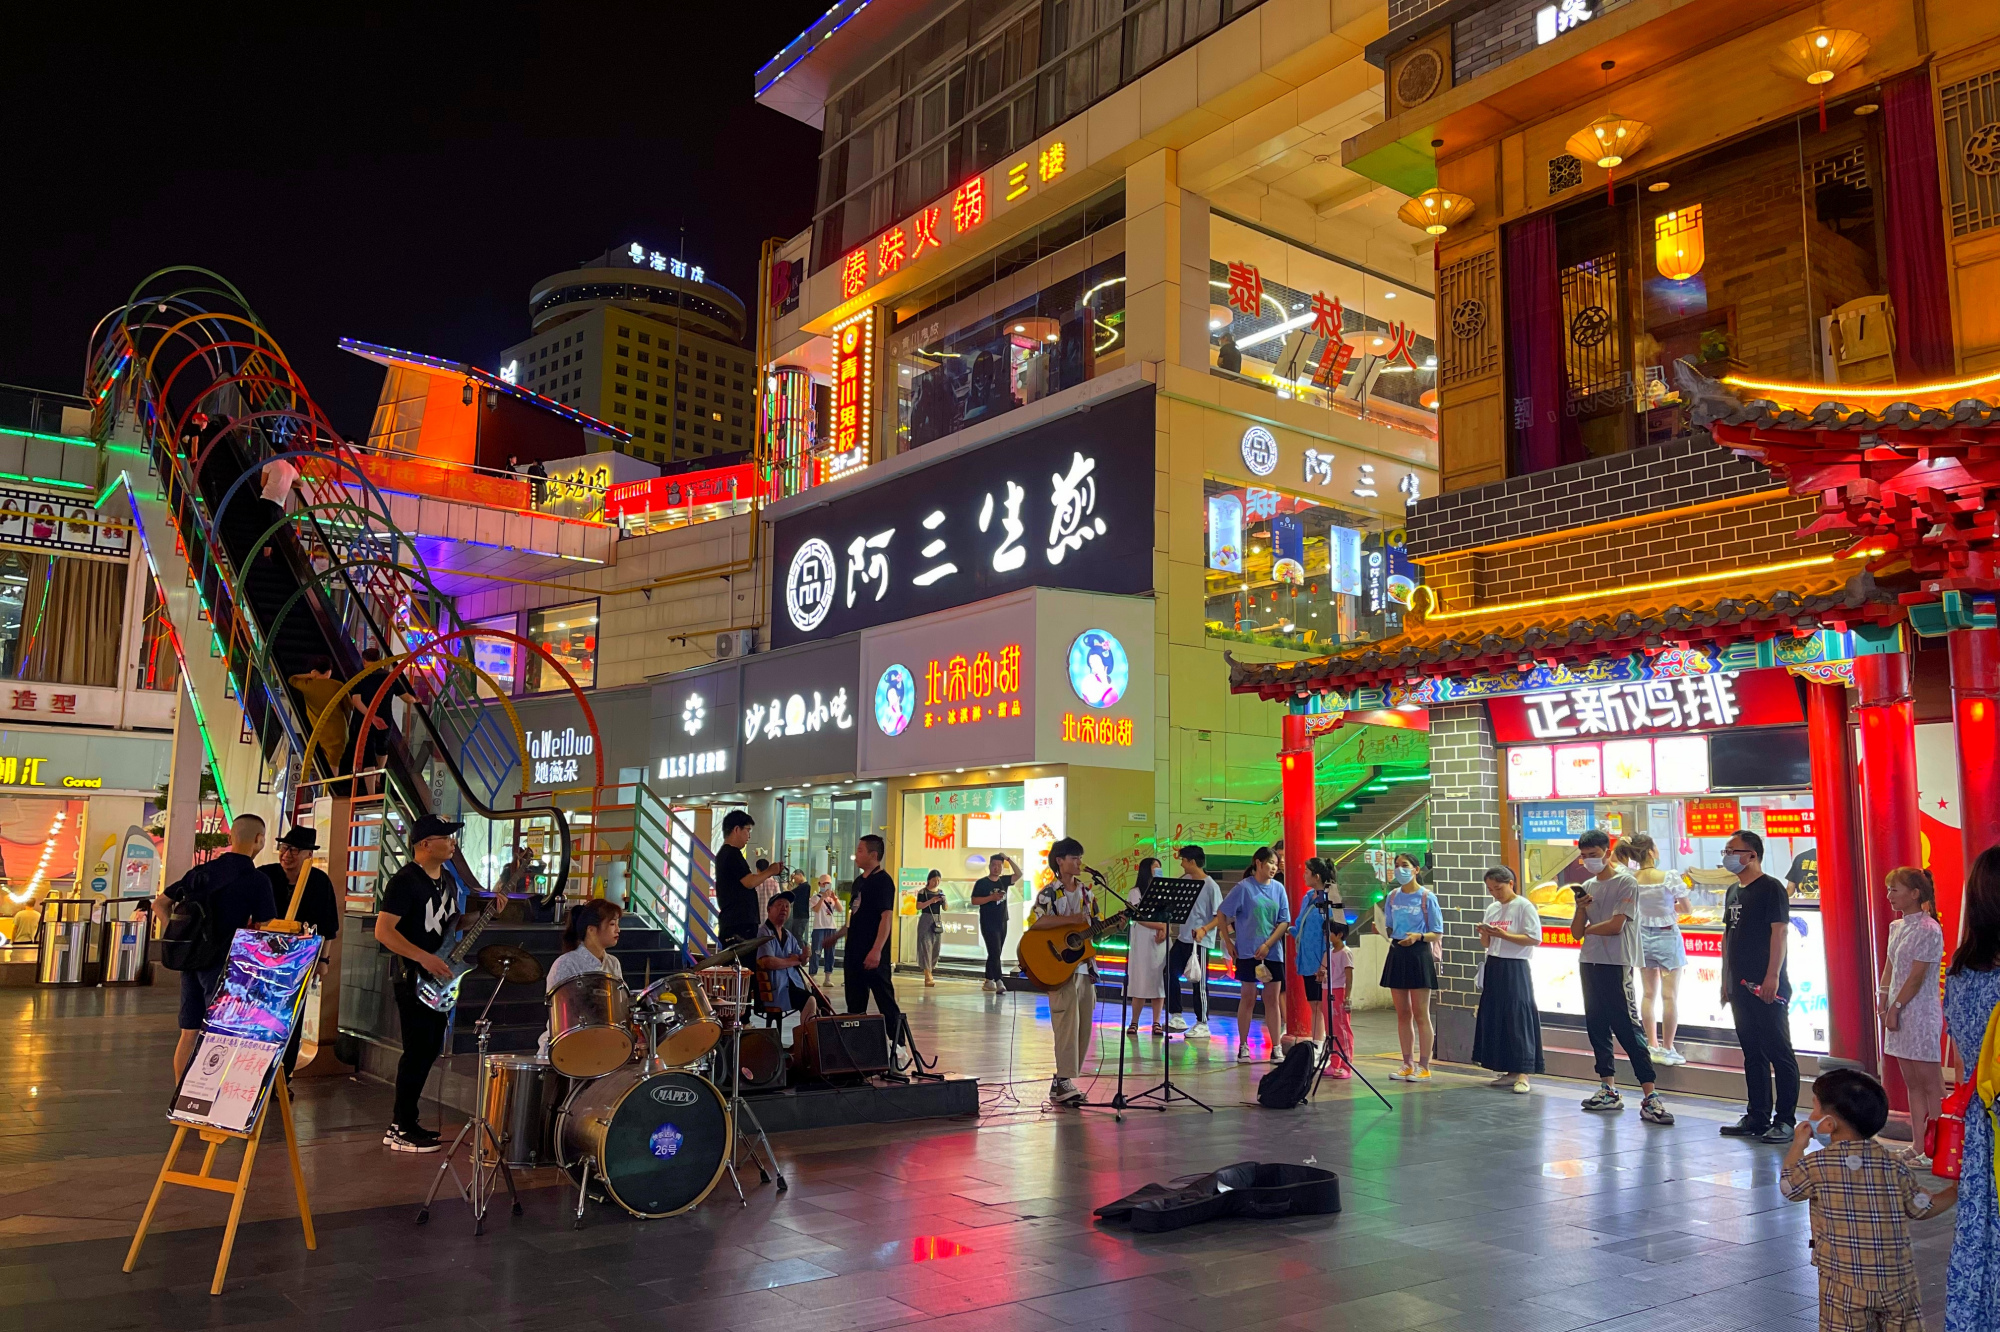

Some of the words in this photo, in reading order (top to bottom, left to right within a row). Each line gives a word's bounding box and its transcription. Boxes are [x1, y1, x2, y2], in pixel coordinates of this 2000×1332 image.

[842, 177, 985, 300] 傣妹火锅
[1006, 141, 1067, 202] 三楼
[628, 242, 706, 283] 粤海酒店
[846, 452, 1107, 609] 阿三生煎
[924, 644, 1021, 706] 北宋的甜
[11, 689, 77, 715] 造型
[744, 687, 853, 745] 沙县小吃
[1522, 673, 1741, 739] 正新鸡排
[1062, 713, 1133, 747] 北宋的甜
[534, 759, 579, 784] 她薇朵
[841, 1020, 860, 1028] JOYO
[656, 1089, 693, 1102] MAPEX
[654, 1144, 678, 1156] 26号
